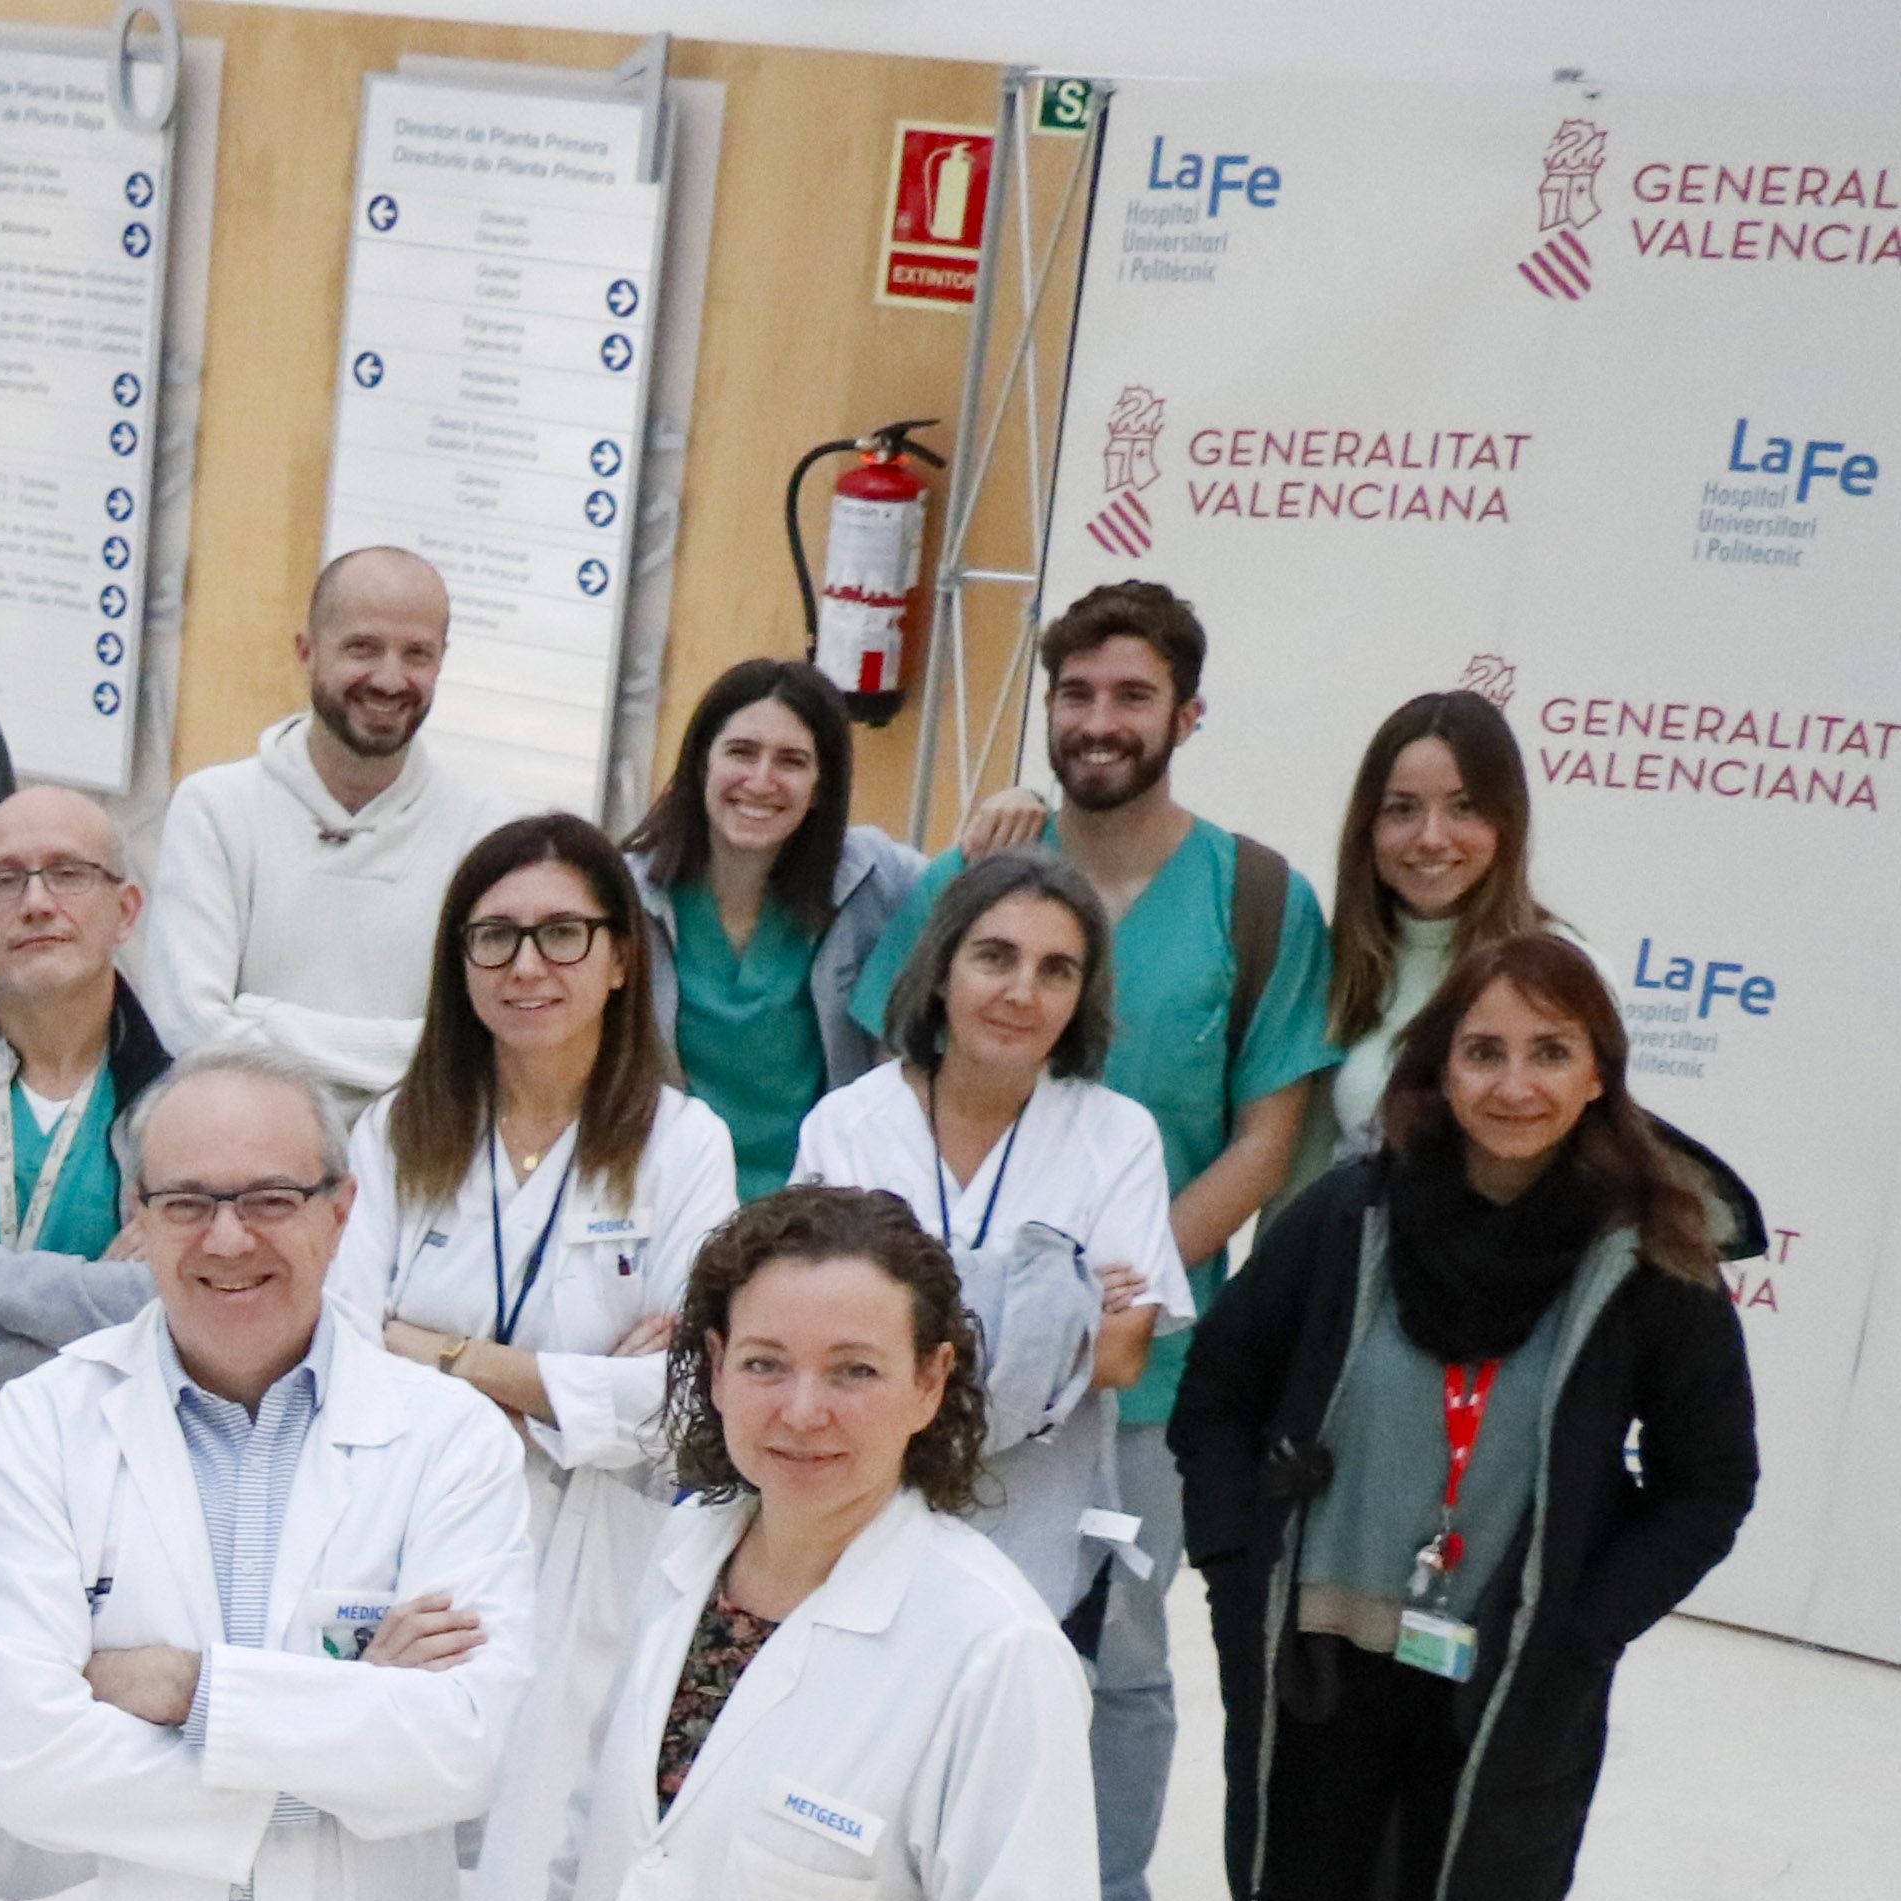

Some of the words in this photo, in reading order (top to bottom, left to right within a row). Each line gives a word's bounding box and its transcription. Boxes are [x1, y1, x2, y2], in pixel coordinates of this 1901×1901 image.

[489, 126, 540, 149] Planta
[545, 132, 609, 156] Primera
[497, 156, 548, 178] Planta
[551, 162, 616, 185] Primera
[1126, 199, 1200, 231] Hospital
[1189, 429, 1533, 471] GENERALITAT
[1188, 480, 1509, 524] VALENCIANA
[1703, 481, 1788, 512] Hospital
[1699, 508, 1817, 539] Universitari
[1541, 698, 1901, 760] GENERALITAT
[1540, 748, 1878, 812] VALENCIANA
[1625, 1002, 1690, 1024] ospital
[784, 1793, 863, 1840] METGESSA
